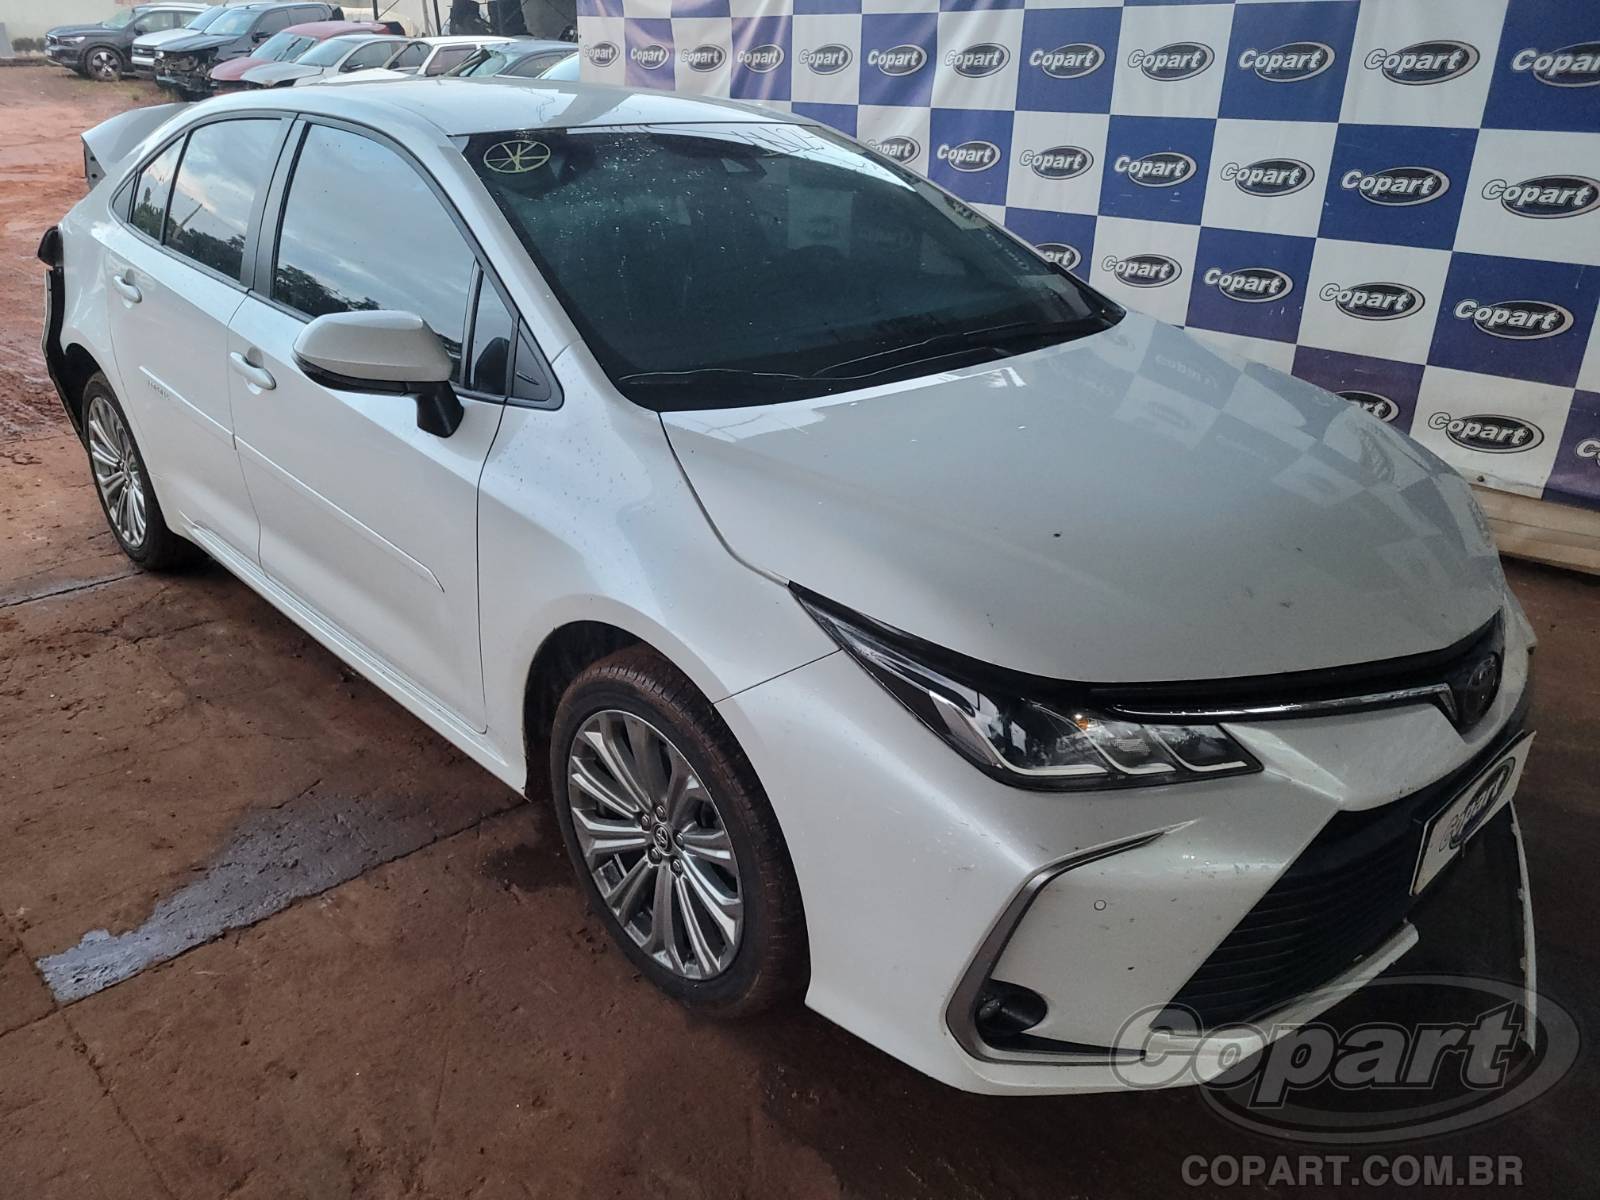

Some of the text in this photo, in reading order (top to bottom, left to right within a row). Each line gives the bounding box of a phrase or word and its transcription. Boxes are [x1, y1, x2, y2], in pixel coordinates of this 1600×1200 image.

[583, 47, 614, 64] Copart
[630, 48, 665, 65] Copart
[681, 49, 719, 66] Copart
[737, 49, 778, 66] Copart
[800, 49, 846, 67] Copart
[867, 49, 921, 69] Copart
[946, 48, 1003, 70] Copart
[1029, 48, 1096, 71] Copart
[1127, 49, 1203, 73] Copart
[1239, 49, 1322, 73] Copart
[1365, 49, 1465, 75] Copart
[937, 144, 992, 164] Copart
[1020, 150, 1083, 171] Copart
[1114, 155, 1189, 179] Copart
[1220, 162, 1300, 188] Copart
[1341, 170, 1437, 197] Copart
[1482, 178, 1592, 209] Copart
[1102, 255, 1171, 281] Copart
[1203, 267, 1281, 296] Copart
[1319, 282, 1410, 312] Copart
[1454, 300, 1558, 331] Copart
[1428, 411, 1530, 444] Copart
